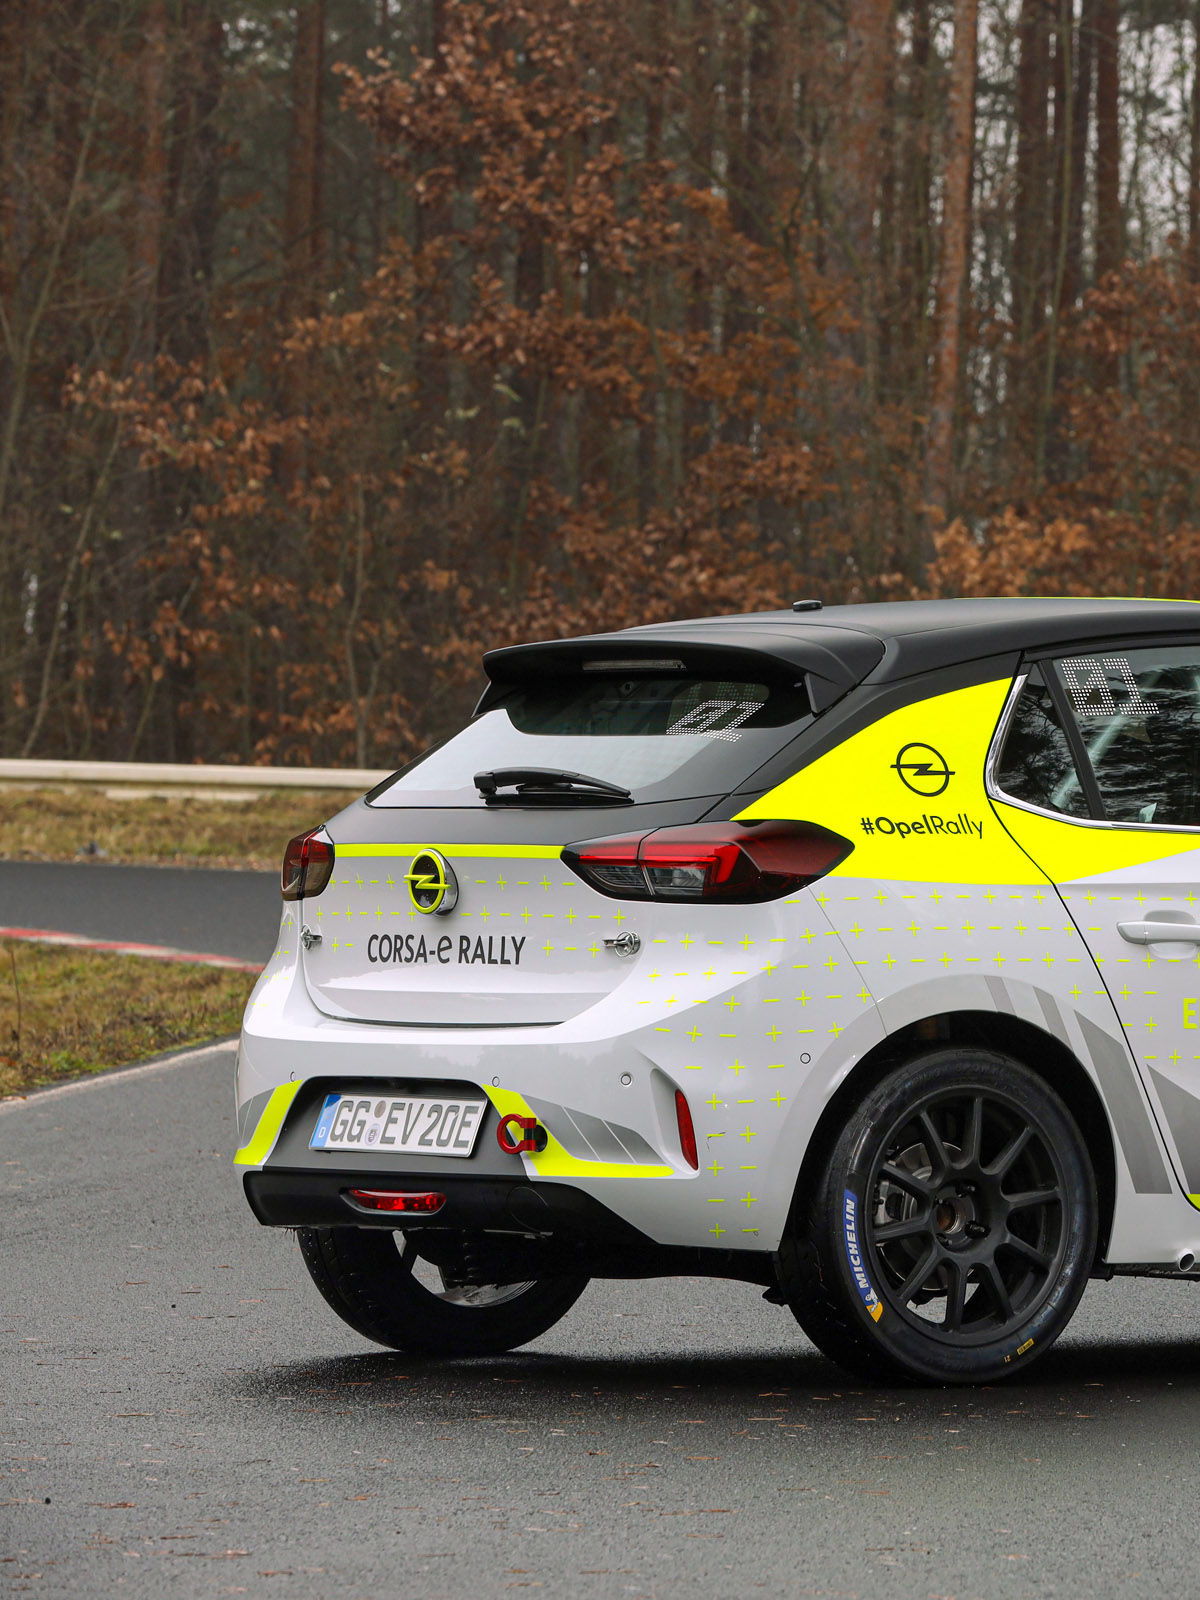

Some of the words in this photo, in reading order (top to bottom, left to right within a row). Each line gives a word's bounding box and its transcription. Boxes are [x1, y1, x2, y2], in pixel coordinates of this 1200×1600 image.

[1061, 658, 1160, 716] 01
[665, 700, 765, 742] 01
[860, 813, 983, 840] #OpelRally
[367, 934, 453, 964] CORSA-e
[457, 935, 527, 965] RALLY
[329, 1100, 372, 1143] GG
[845, 1198, 869, 1289] MICHELIN
